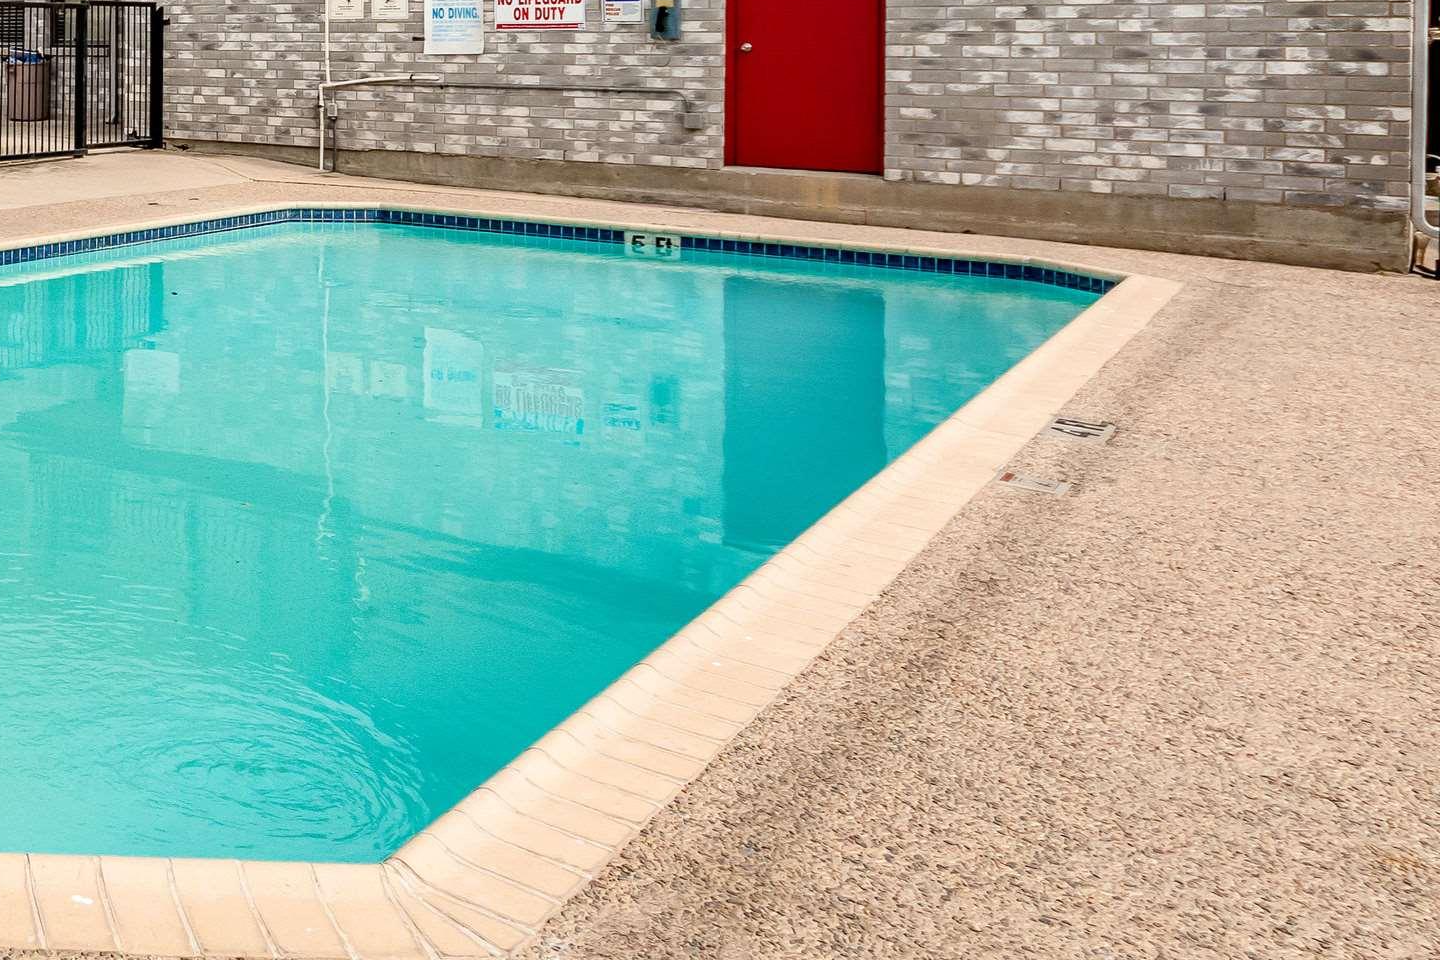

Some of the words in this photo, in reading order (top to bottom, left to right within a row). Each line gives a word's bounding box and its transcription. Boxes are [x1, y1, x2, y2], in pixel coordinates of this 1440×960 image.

[432, 7, 445, 19] NO
[513, 7, 529, 20] ON
[534, 7, 566, 20] DUTY
